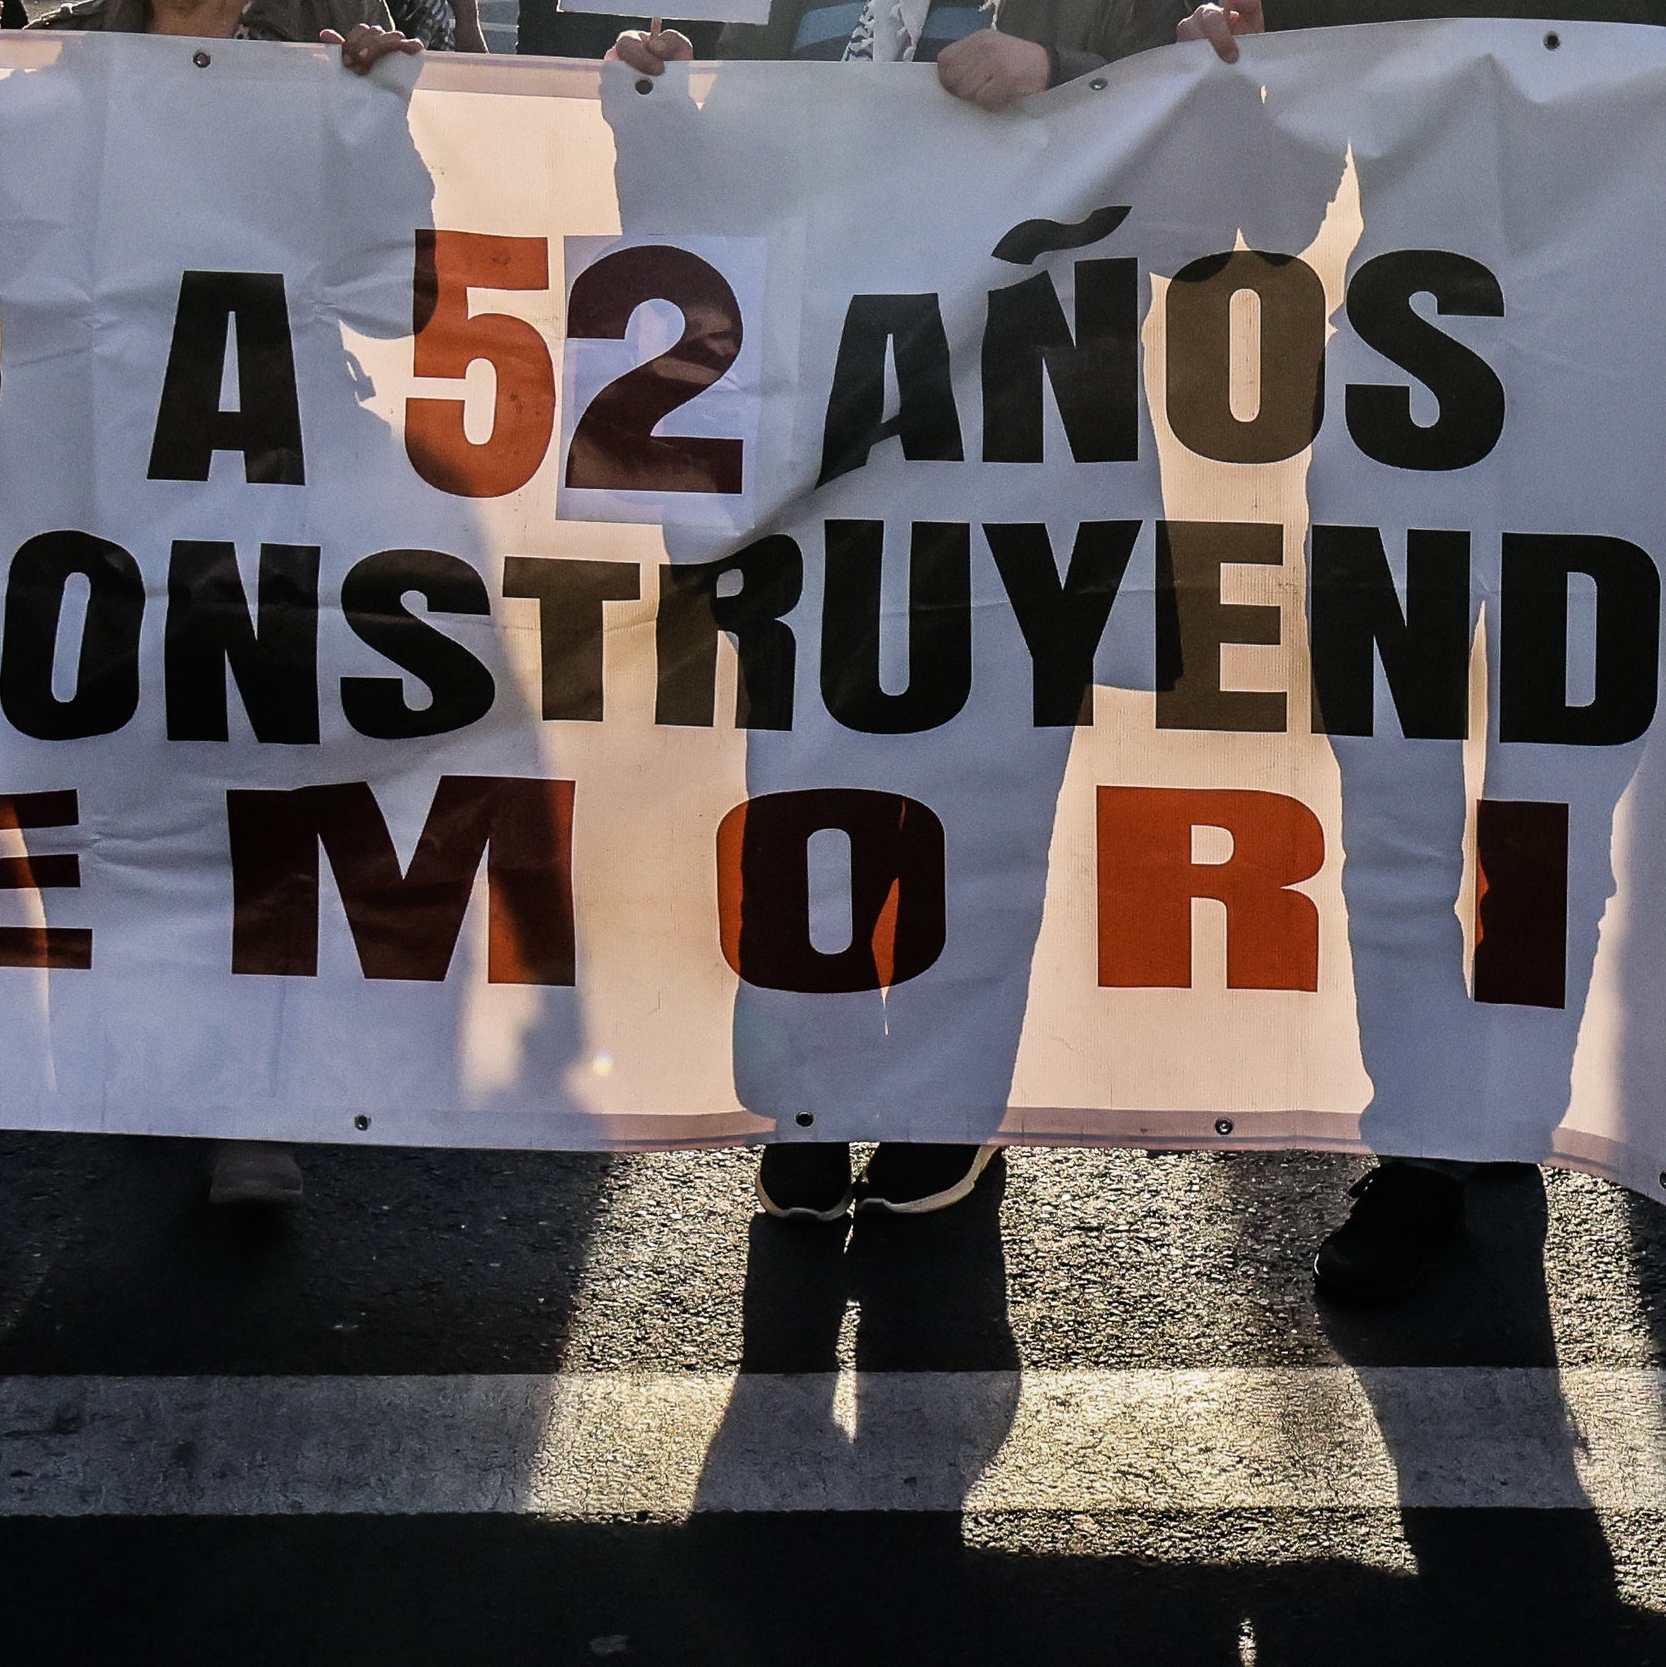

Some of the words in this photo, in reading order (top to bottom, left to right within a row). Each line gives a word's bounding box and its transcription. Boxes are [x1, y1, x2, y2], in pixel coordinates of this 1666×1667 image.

[146, 270, 306, 485] A
[404, 228, 744, 498] 52
[815, 206, 1504, 488] AÑOS
